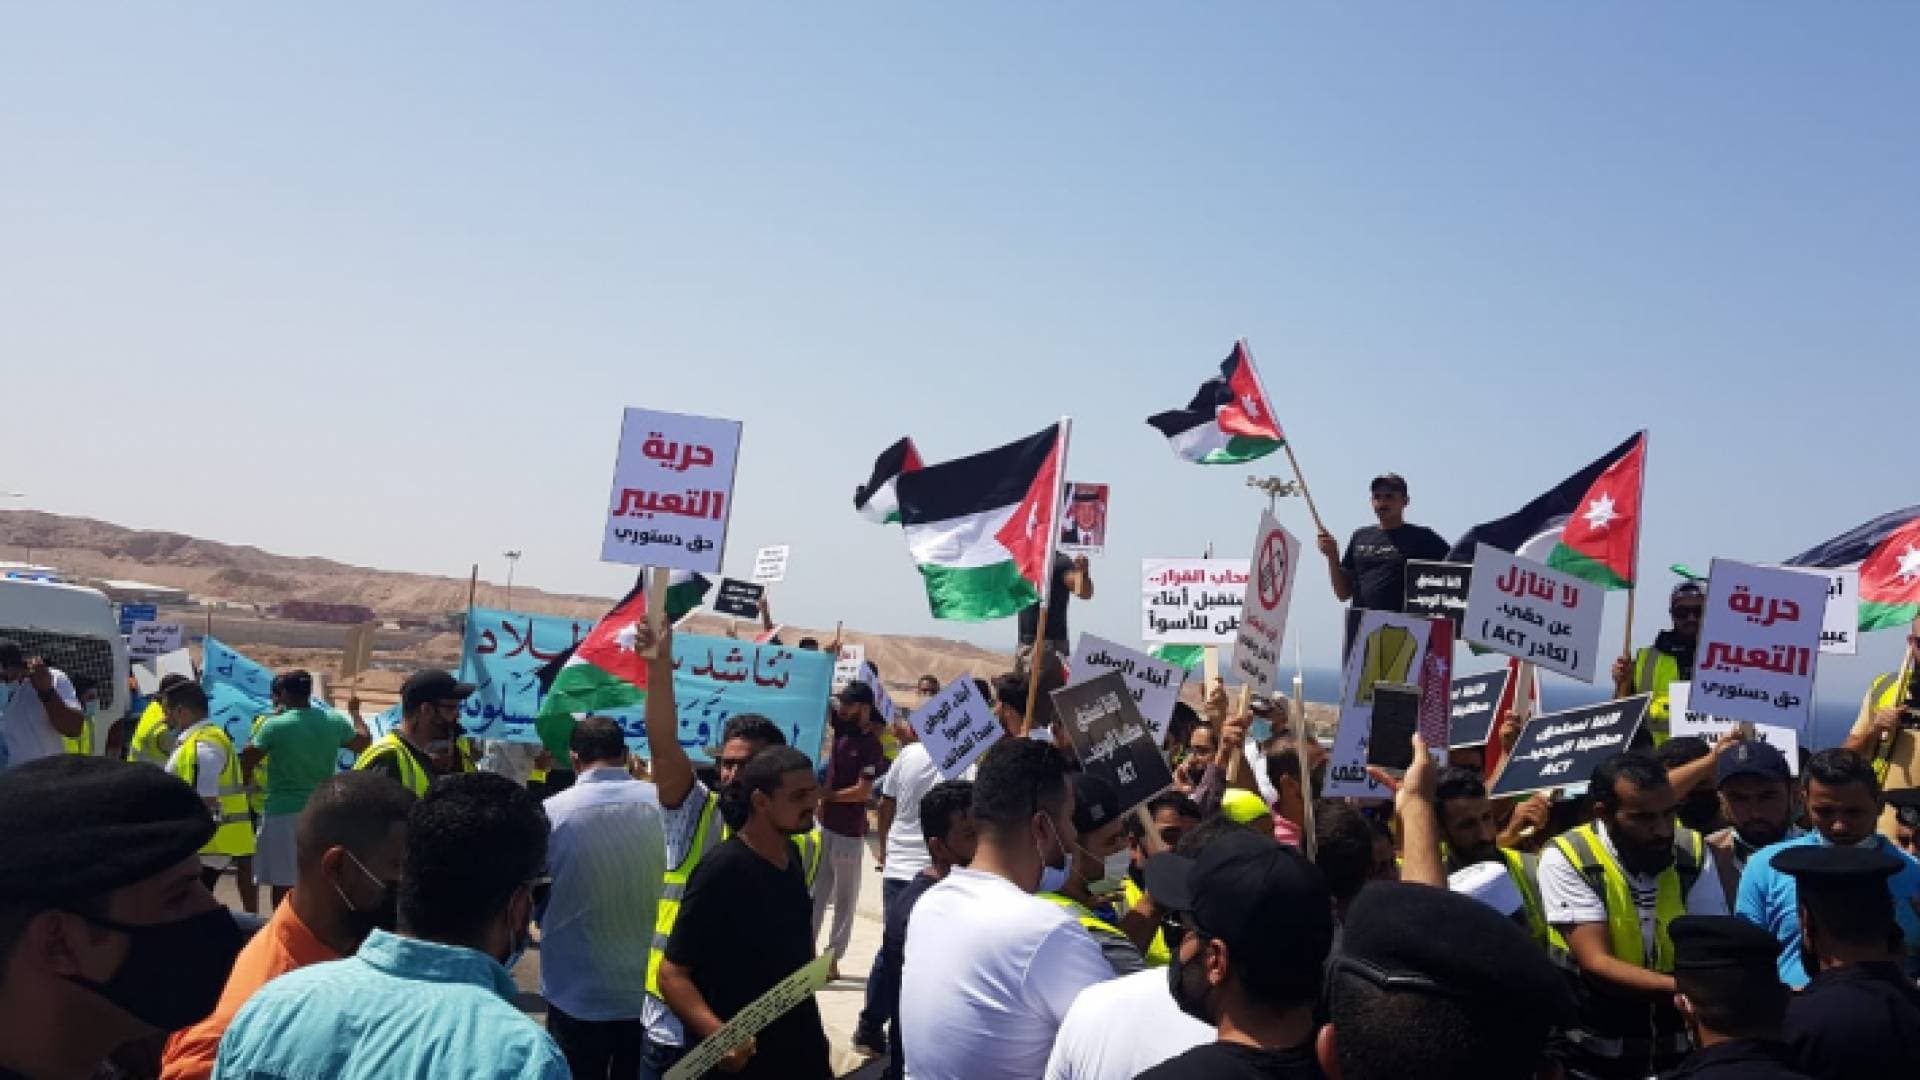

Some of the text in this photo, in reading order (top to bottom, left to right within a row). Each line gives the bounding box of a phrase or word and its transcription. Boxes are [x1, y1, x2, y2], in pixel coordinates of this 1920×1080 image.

[642, 431, 714, 472] حرية
[612, 487, 724, 520] التعبير
[615, 528, 714, 552] حق دستوري
[1152, 586, 1189, 609] أبناء
[1496, 563, 1580, 608] لا تنازل
[1728, 585, 1800, 626] حرية
[1548, 620, 1573, 636] عن
[1700, 642, 1810, 676] التعبير
[1136, 666, 1173, 688] أبناء
[1701, 680, 1800, 710] حق دستوري
